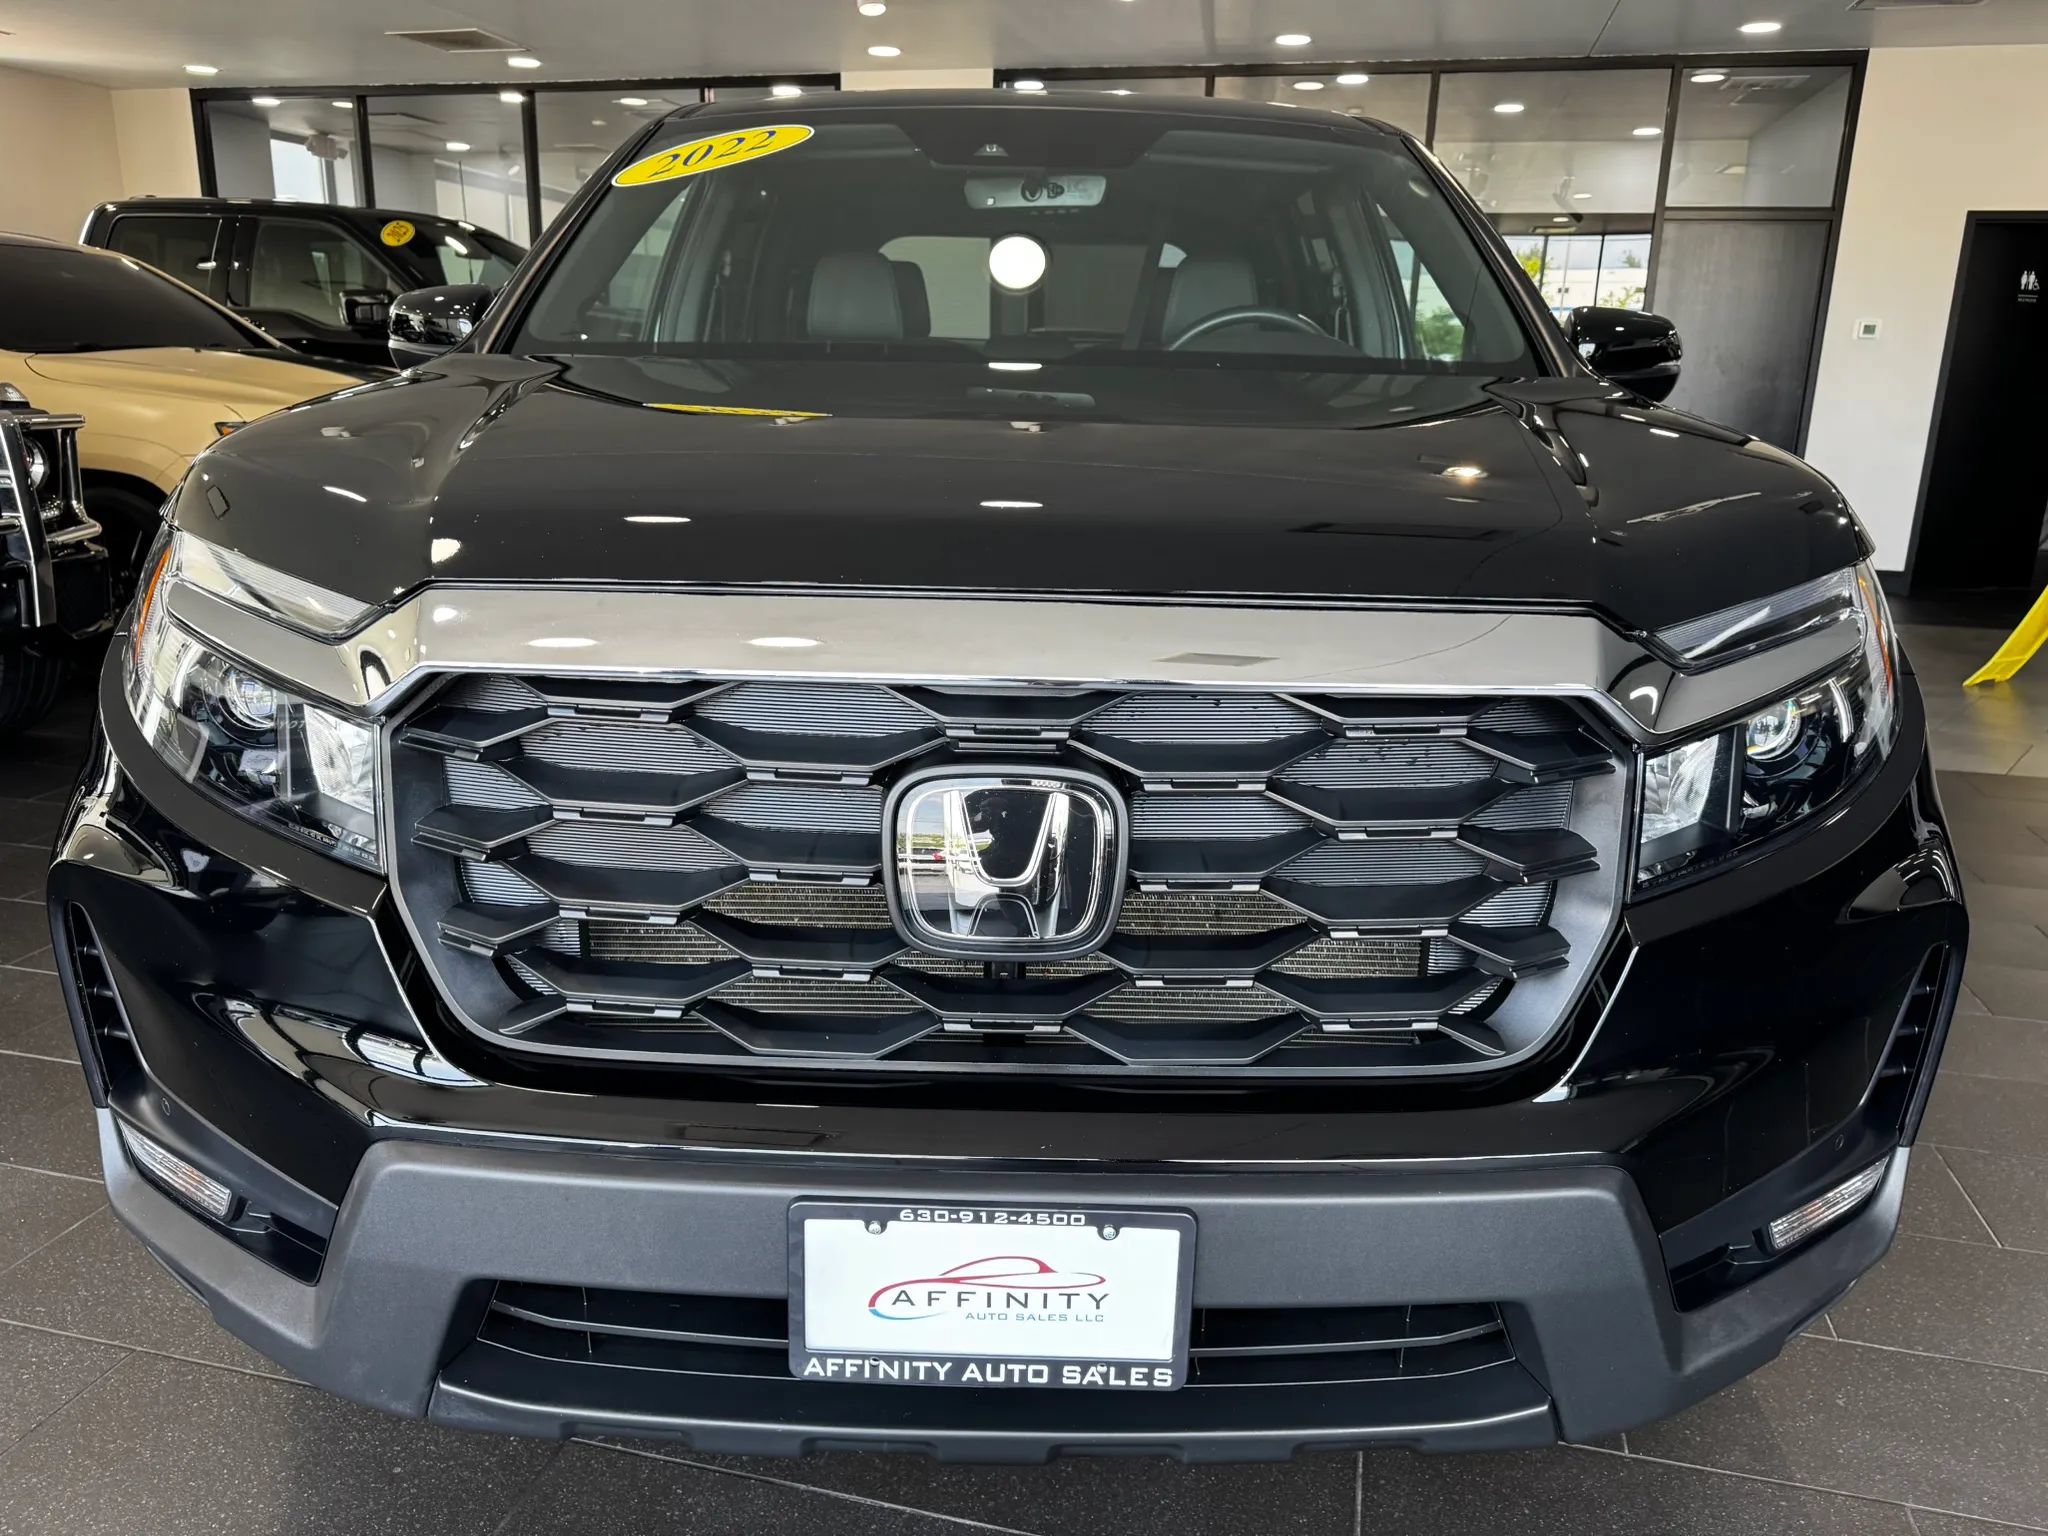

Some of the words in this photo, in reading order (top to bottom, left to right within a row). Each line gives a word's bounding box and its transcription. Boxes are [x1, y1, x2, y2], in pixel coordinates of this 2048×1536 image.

[647, 130, 777, 179] 2022
[899, 1209, 1086, 1226] 630-912-4500
[892, 1289, 1109, 1310] AFFINITY
[965, 1312, 1008, 1321] AUTO
[1015, 1313, 1068, 1322] SALES
[1075, 1315, 1104, 1323] LLC
[803, 1357, 953, 1381] AFFINITY
[961, 1363, 1049, 1383] AUTO
[1062, 1366, 1173, 1387] SALES
